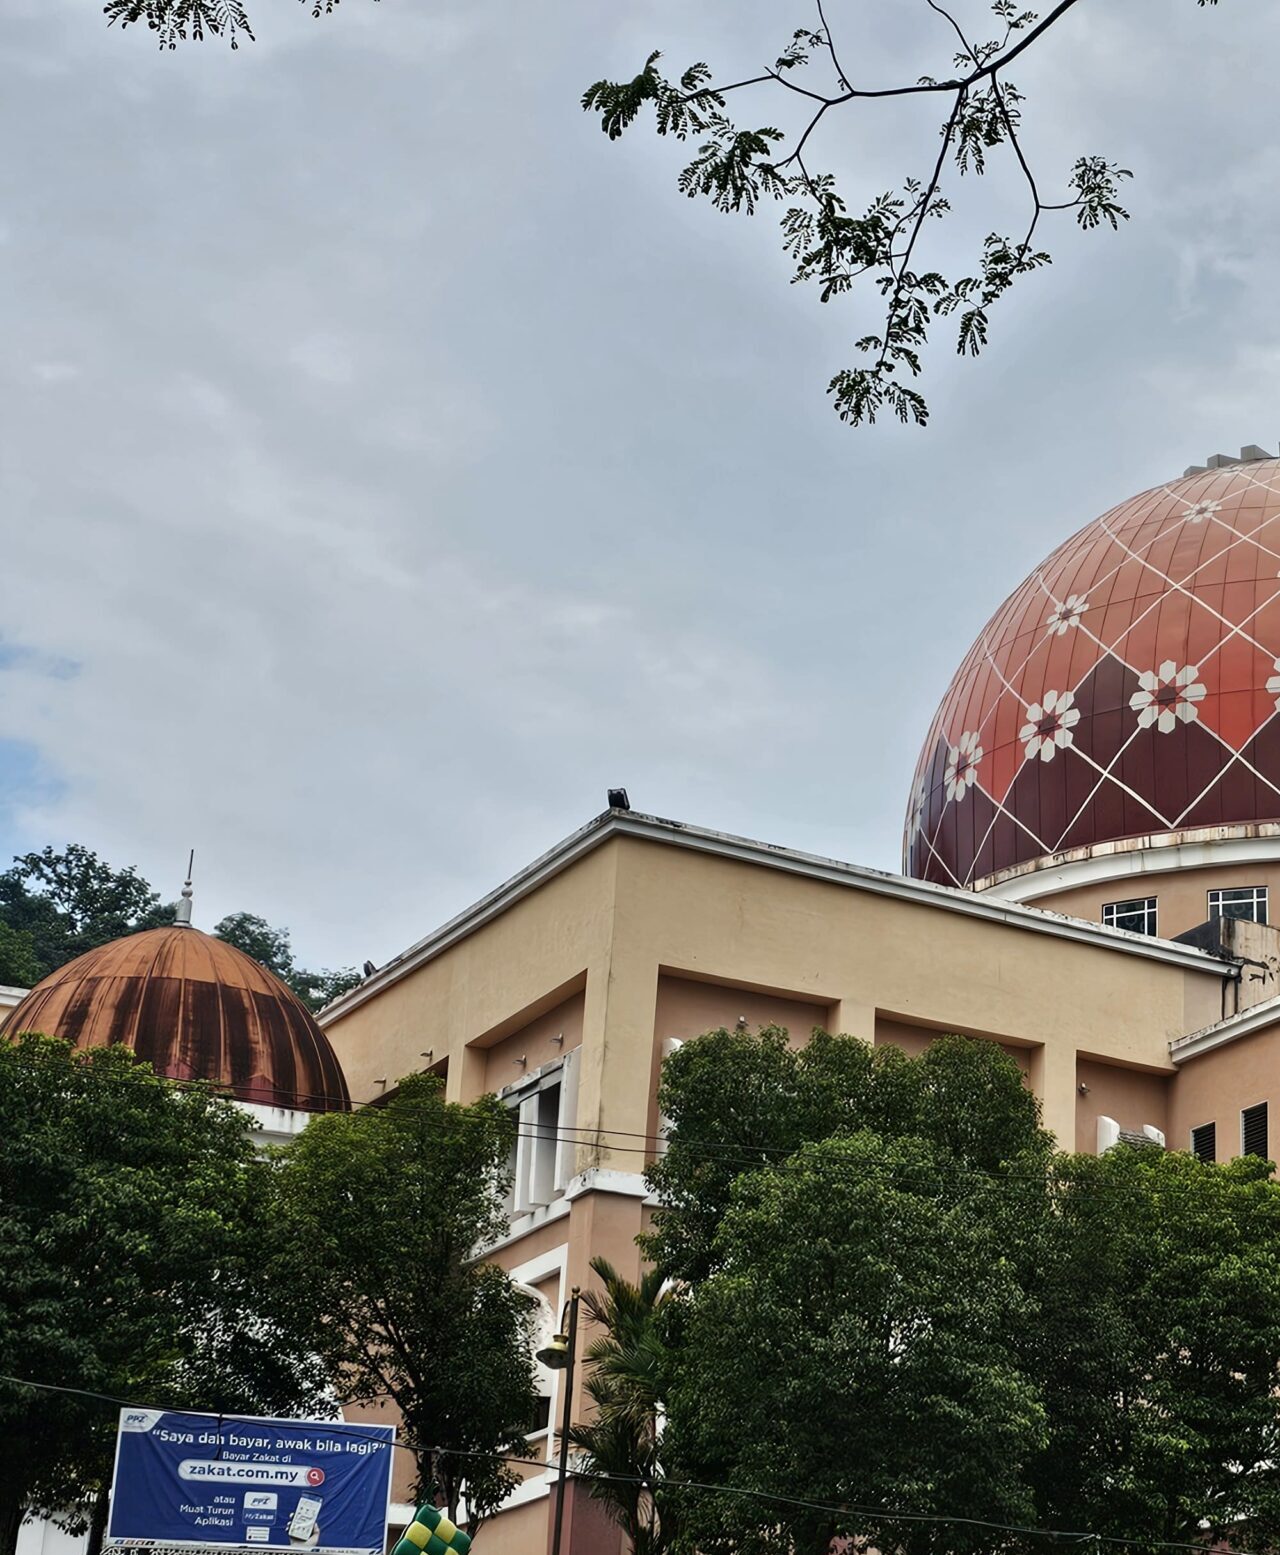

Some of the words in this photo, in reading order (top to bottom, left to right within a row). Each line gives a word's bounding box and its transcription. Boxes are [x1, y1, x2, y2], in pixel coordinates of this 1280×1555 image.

[198, 1432, 225, 1445] dah
[229, 1434, 271, 1449] bayar,
[276, 1439, 312, 1451] awak
[316, 1439, 342, 1452] bila
[222, 1451, 250, 1461] Bayar
[253, 1453, 280, 1462] Zakat
[282, 1455, 292, 1463] di
[189, 1464, 298, 1482] zakat.com.my
[214, 1495, 236, 1504] atau
[180, 1504, 204, 1513] Muat
[207, 1505, 234, 1515] Turun
[194, 1516, 234, 1526] Aplikasi
